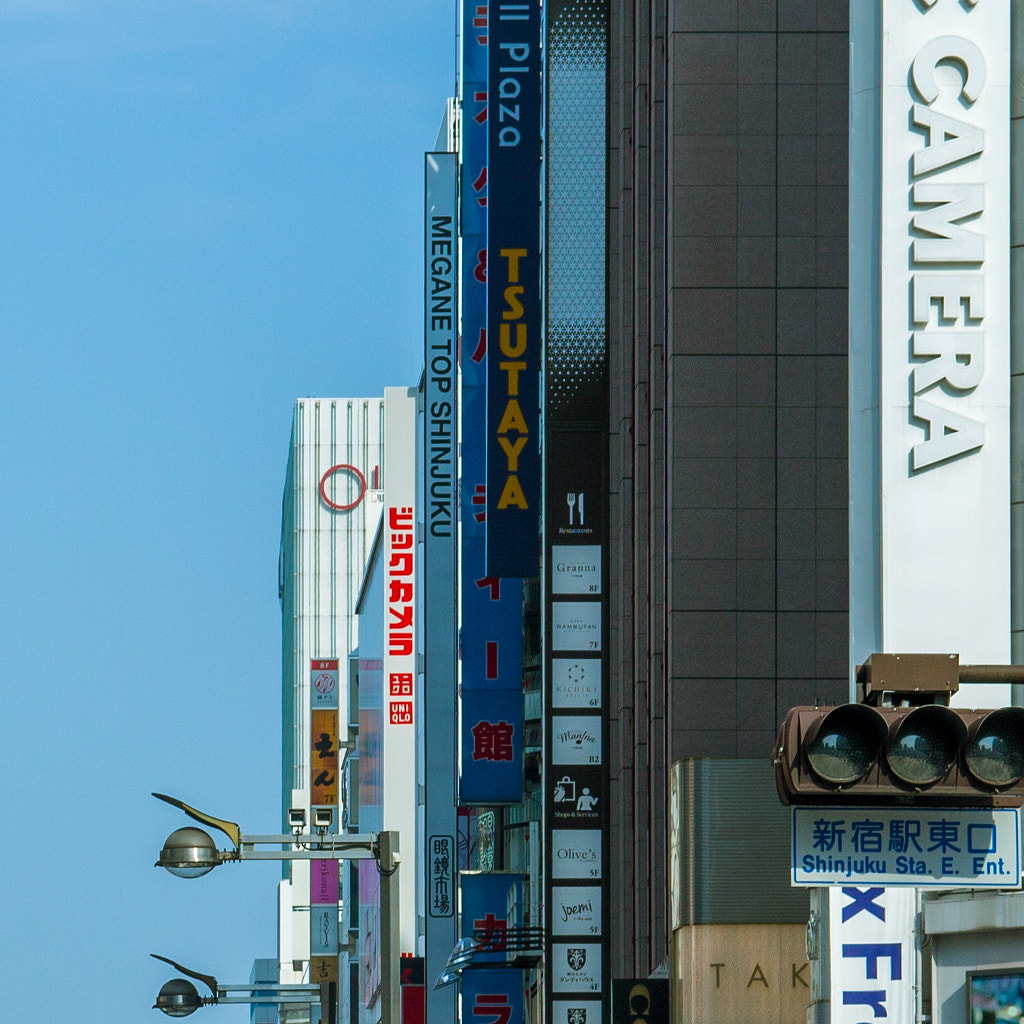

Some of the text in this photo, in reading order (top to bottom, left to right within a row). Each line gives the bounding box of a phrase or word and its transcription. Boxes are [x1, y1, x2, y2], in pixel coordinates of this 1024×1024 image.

[498, 43, 530, 147] Plaza
[911, 35, 987, 471] CAMERA
[430, 216, 452, 538] MEGANE TOP SHINJUKU
[497, 248, 529, 509] TSUTAYA
[556, 562, 596, 572] Granna
[389, 507, 413, 656] ビックカメラ
[589, 584, 600, 592] 8F
[589, 641, 600, 649] 7F
[589, 699, 600, 707] 6F
[812, 818, 997, 854] 新宿駅東口
[557, 848, 597, 861] Olive's
[589, 869, 600, 877] 5F
[802, 856, 1011, 878] Shinjuku Sta. E. Ent.
[433, 838, 450, 914] 眼鏡市場
[589, 926, 600, 934] 5F
[589, 983, 600, 991] 4F
